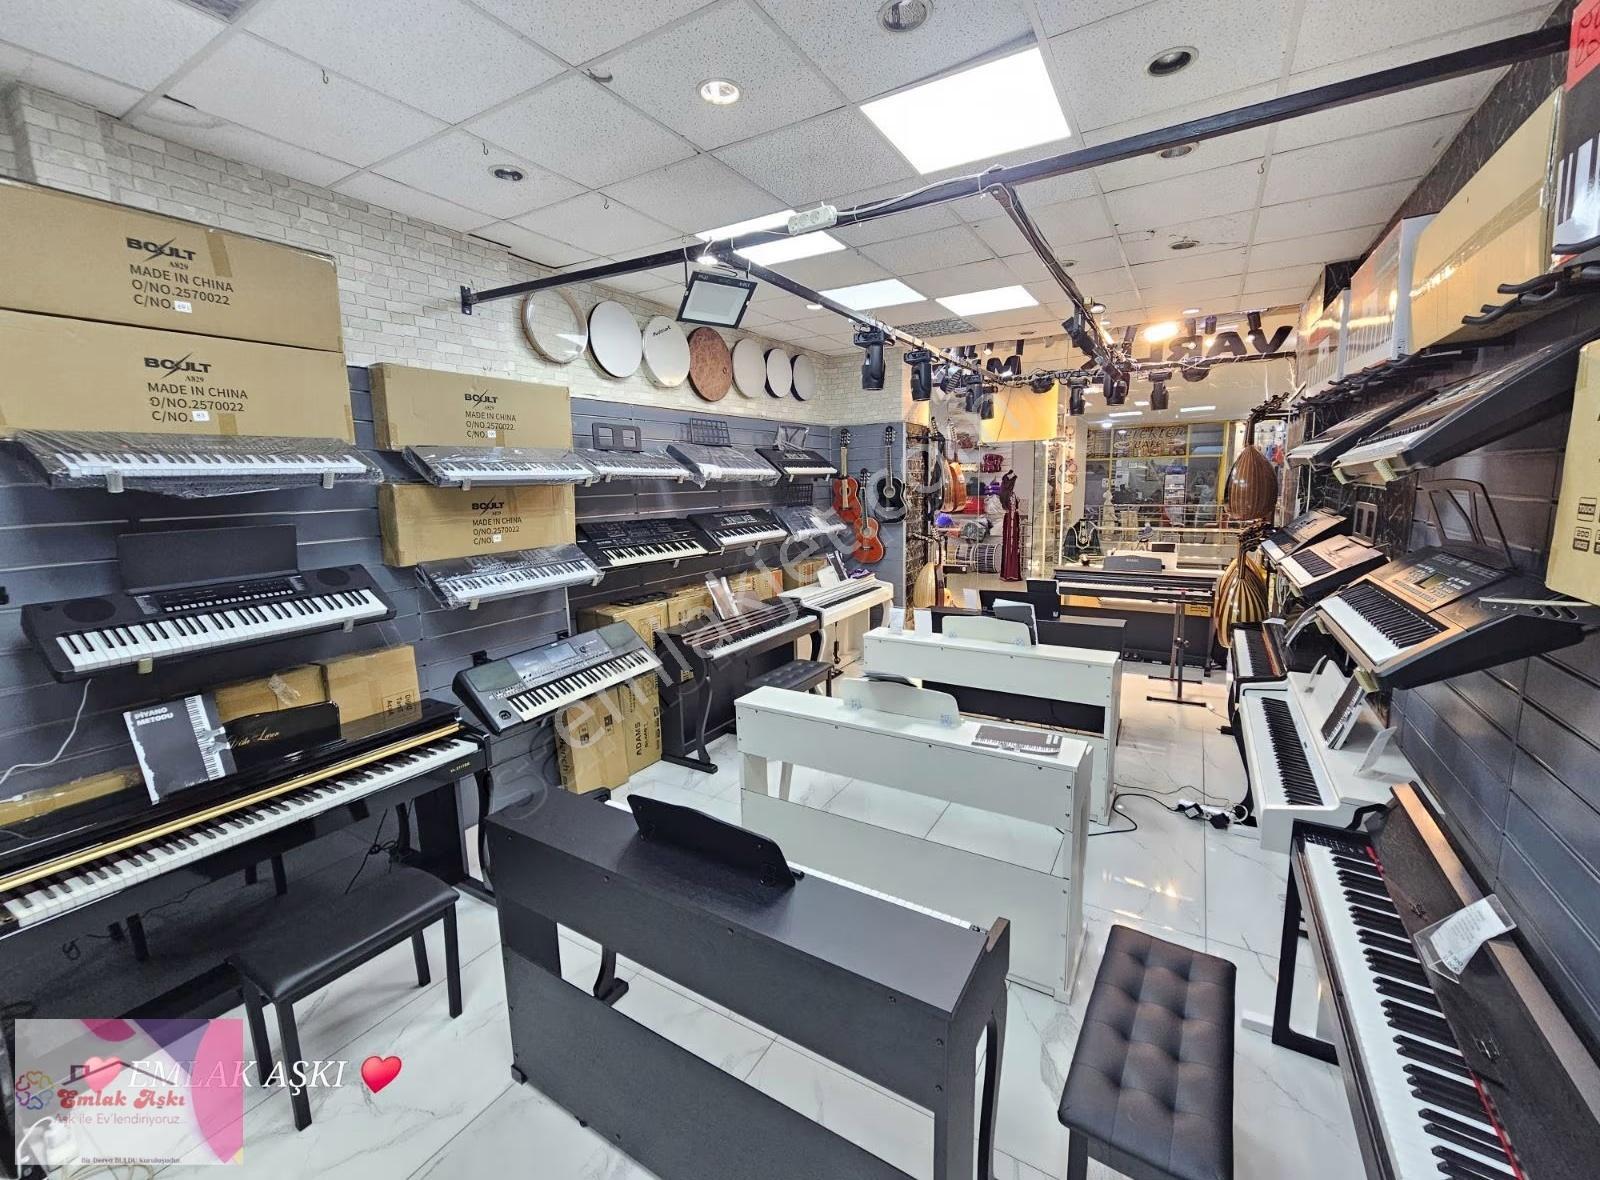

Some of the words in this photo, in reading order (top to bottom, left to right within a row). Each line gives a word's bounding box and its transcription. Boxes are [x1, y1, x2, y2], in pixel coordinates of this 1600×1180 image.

[129, 264, 171, 281] MADE
[175, 272, 189, 285] IN
[193, 276, 234, 292] CHINA
[132, 279, 231, 306] O/NO.2570022
[133, 294, 175, 310] C/NO.
[147, 382, 188, 395] MADE
[191, 386, 205, 396] IN
[208, 387, 248, 399] CHINA
[150, 396, 245, 412] O/NO.2570022
[152, 410, 193, 422] C/NO.
[465, 410, 486, 419] MADE
[495, 413, 516, 422] CHINA
[472, 518, 492, 526] MADE
[501, 516, 521, 524] CHINA
[634, 721, 642, 756] ADAMS
